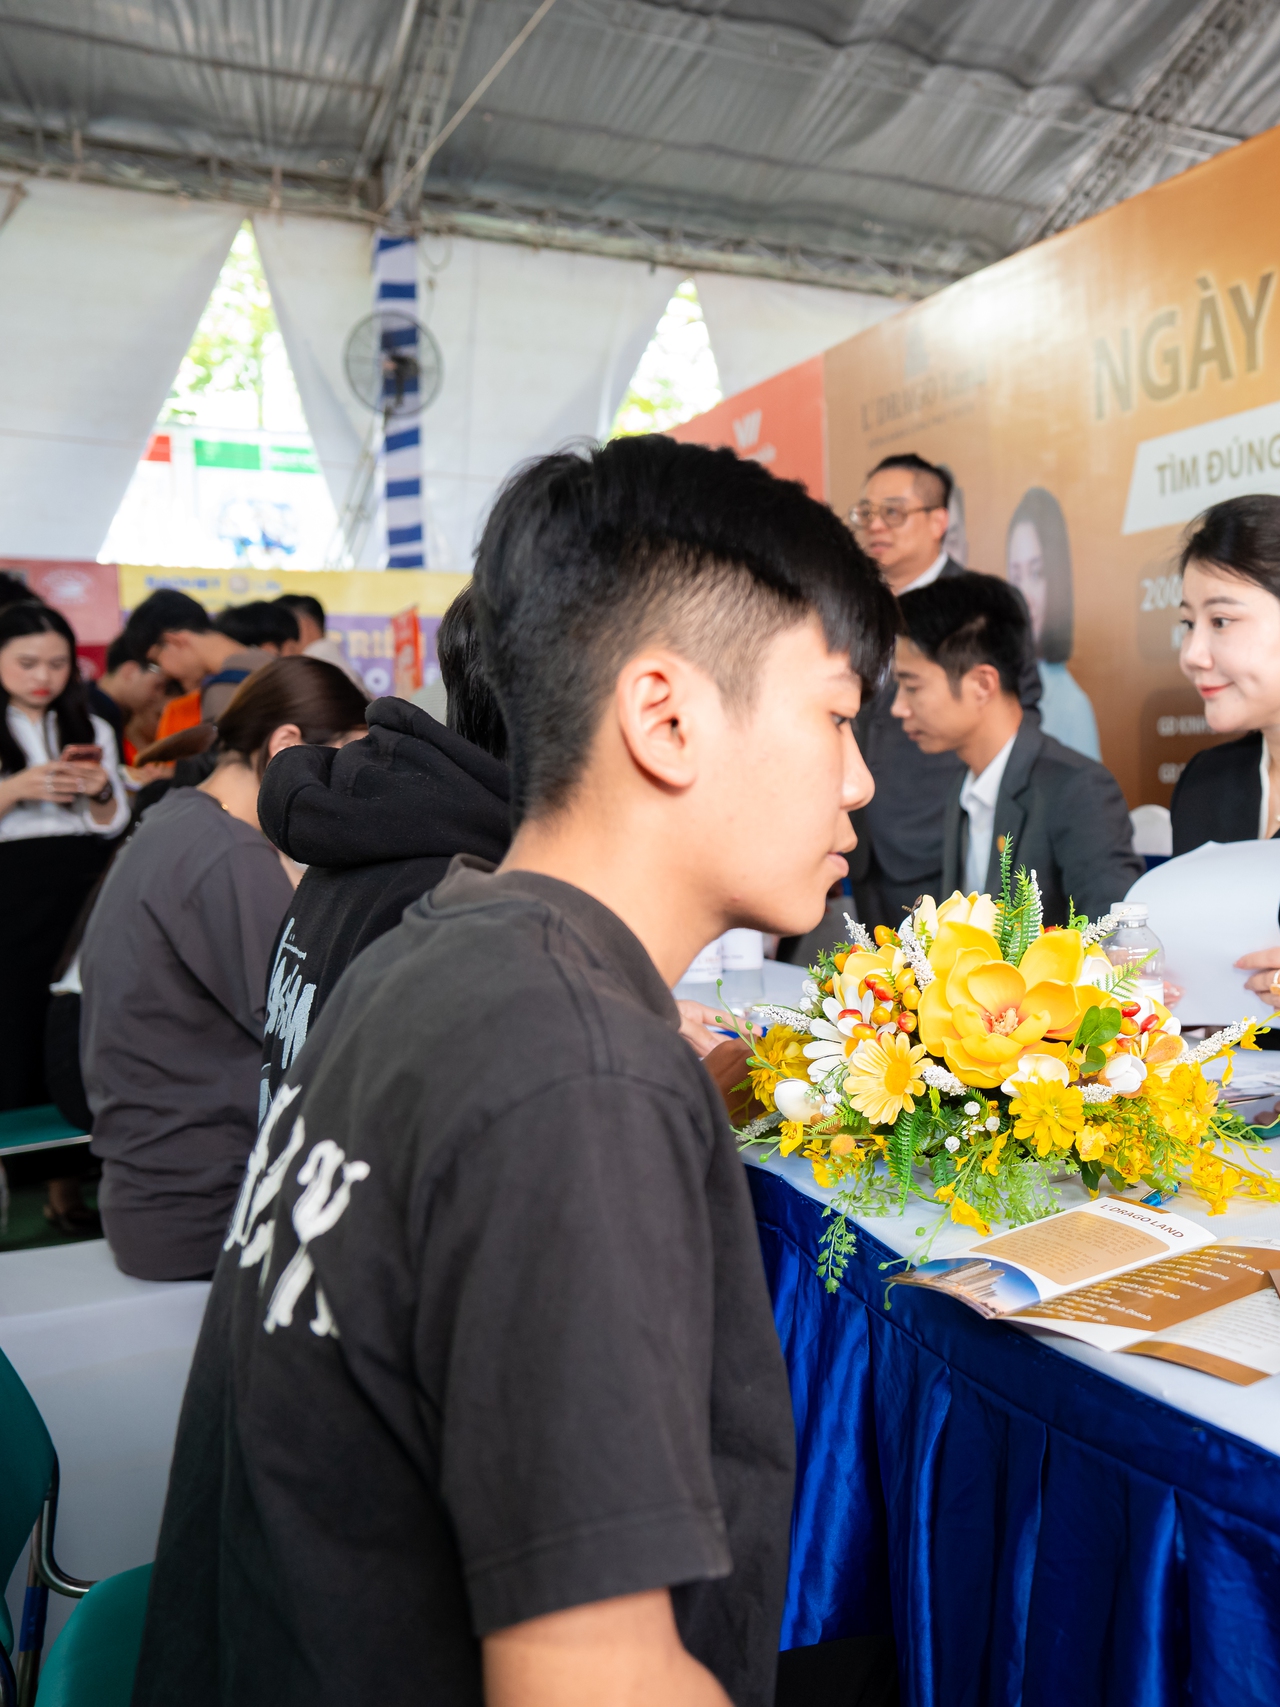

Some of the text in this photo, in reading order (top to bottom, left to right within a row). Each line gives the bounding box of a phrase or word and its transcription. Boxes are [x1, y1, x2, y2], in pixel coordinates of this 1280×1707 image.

[1092, 272, 1274, 420] NGÀY
[1155, 451, 1201, 497] TÌM
[1150, 1220, 1184, 1238] LAND
